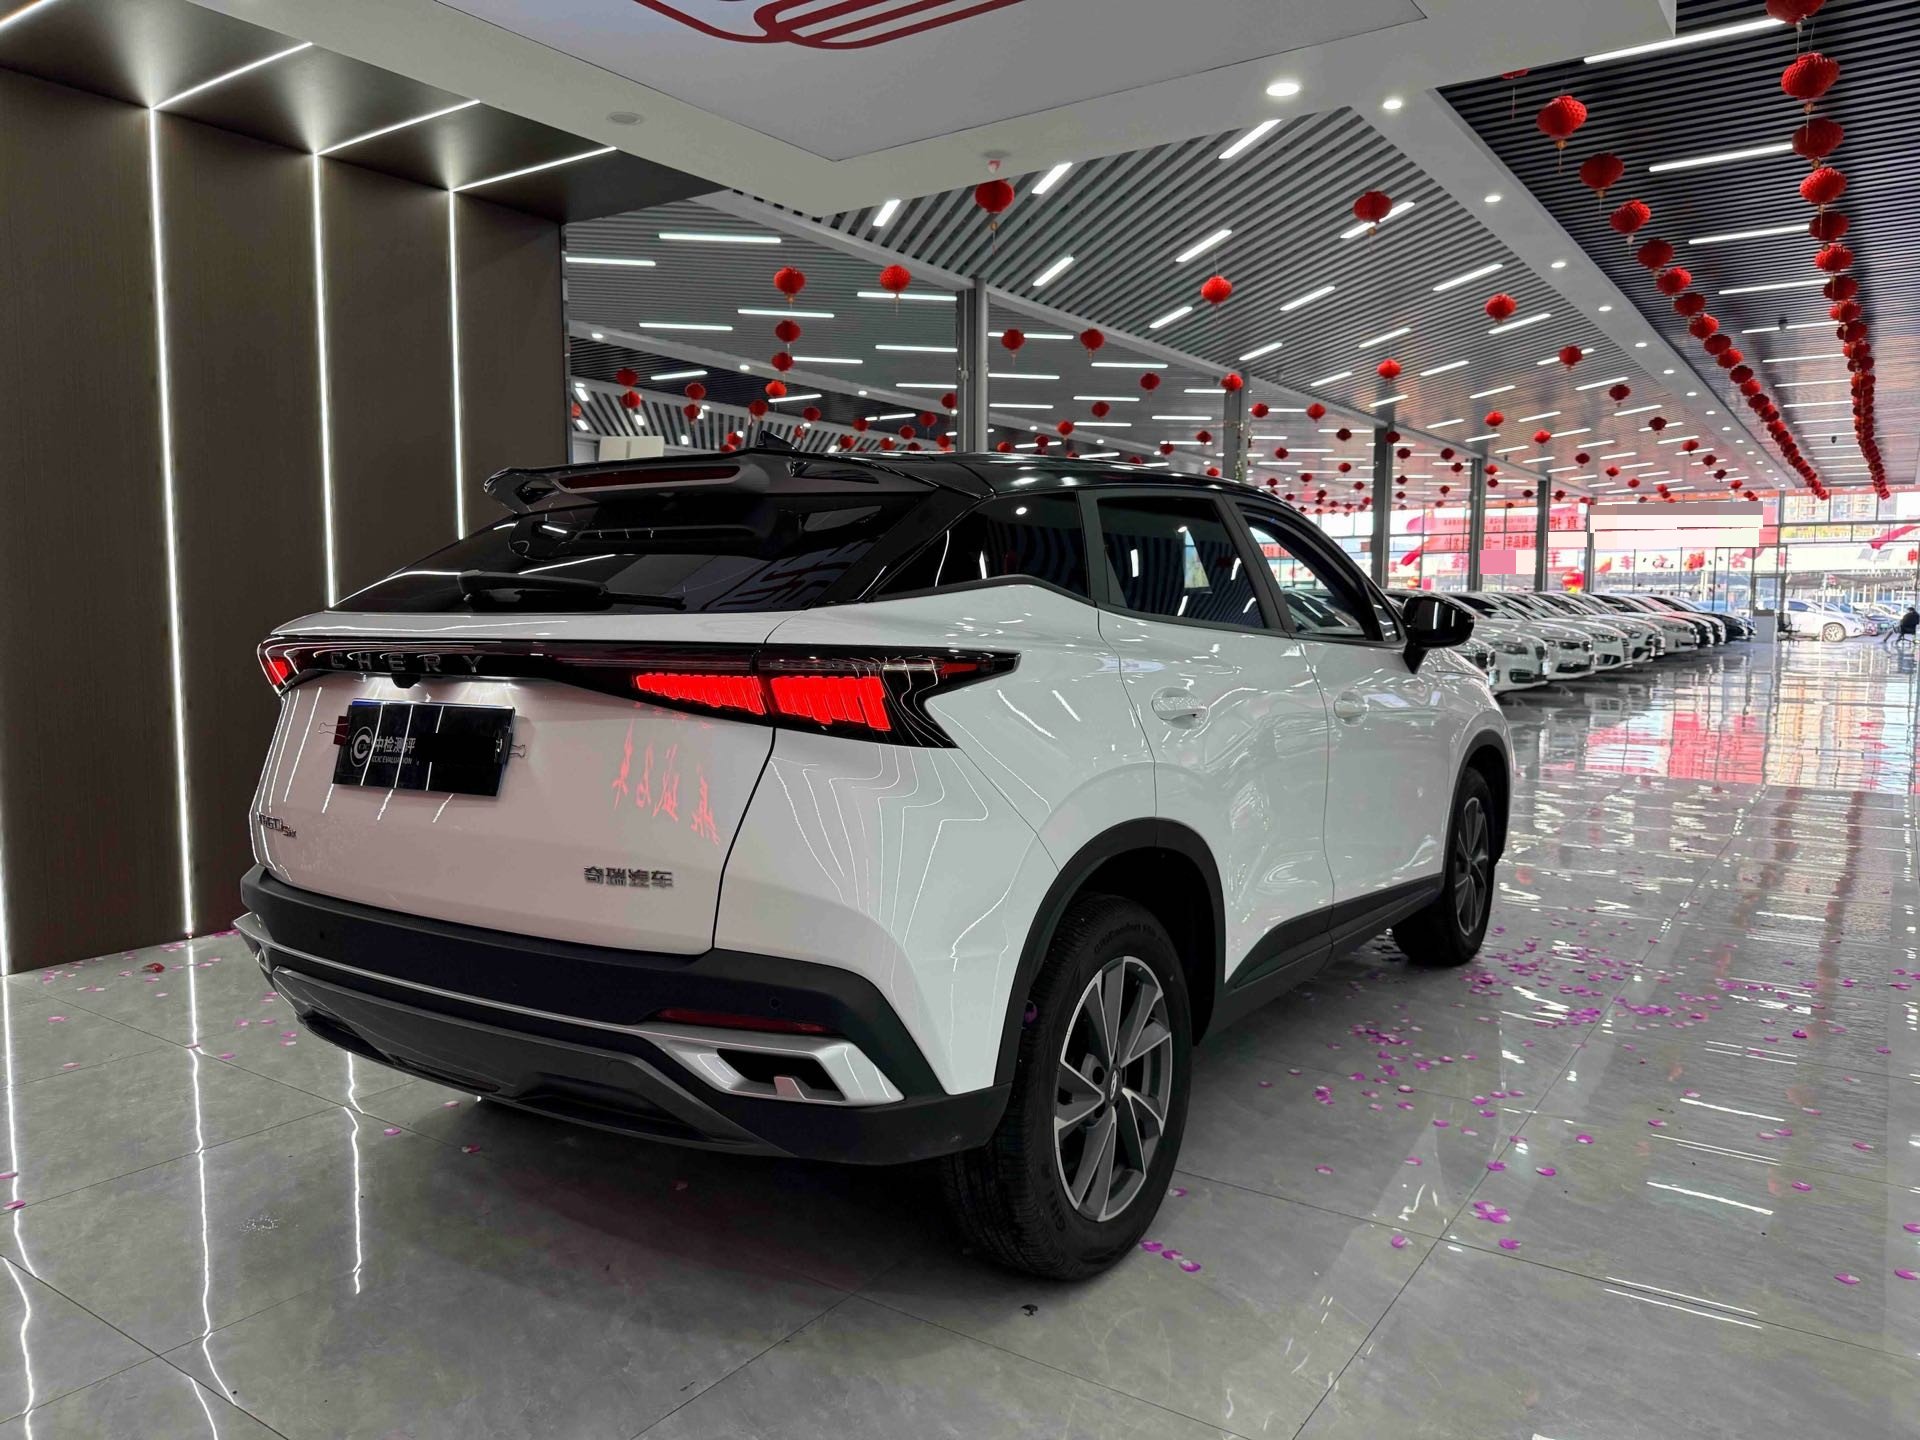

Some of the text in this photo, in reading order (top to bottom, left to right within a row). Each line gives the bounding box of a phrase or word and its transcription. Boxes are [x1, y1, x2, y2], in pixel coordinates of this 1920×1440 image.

[329, 652, 483, 673] CHERY
[374, 735, 417, 754] 中检测评
[583, 866, 673, 888] 奇瑞汽车
